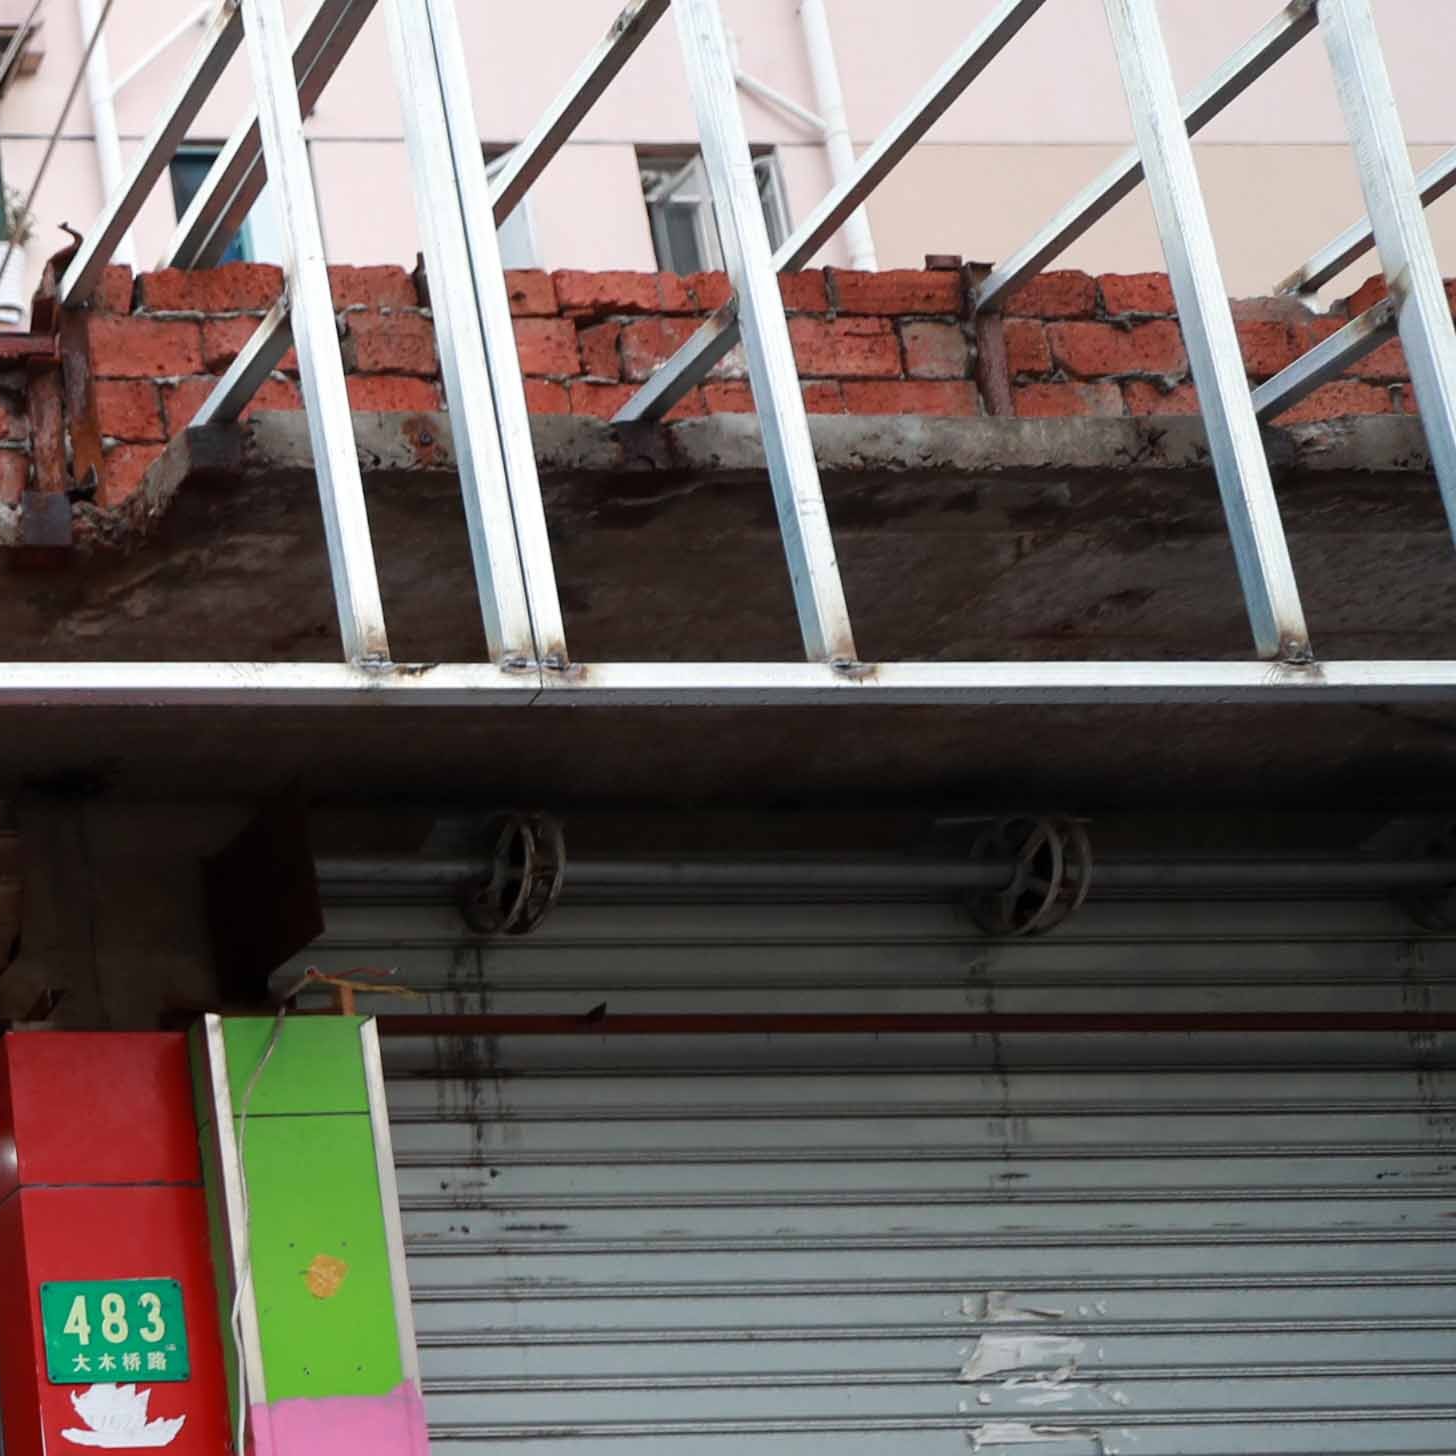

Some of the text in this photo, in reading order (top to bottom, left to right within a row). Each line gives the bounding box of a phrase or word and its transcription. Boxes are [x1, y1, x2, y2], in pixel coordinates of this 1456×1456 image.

[64, 1293, 164, 1344] 483
[73, 1352, 166, 1371] 大木桥路
